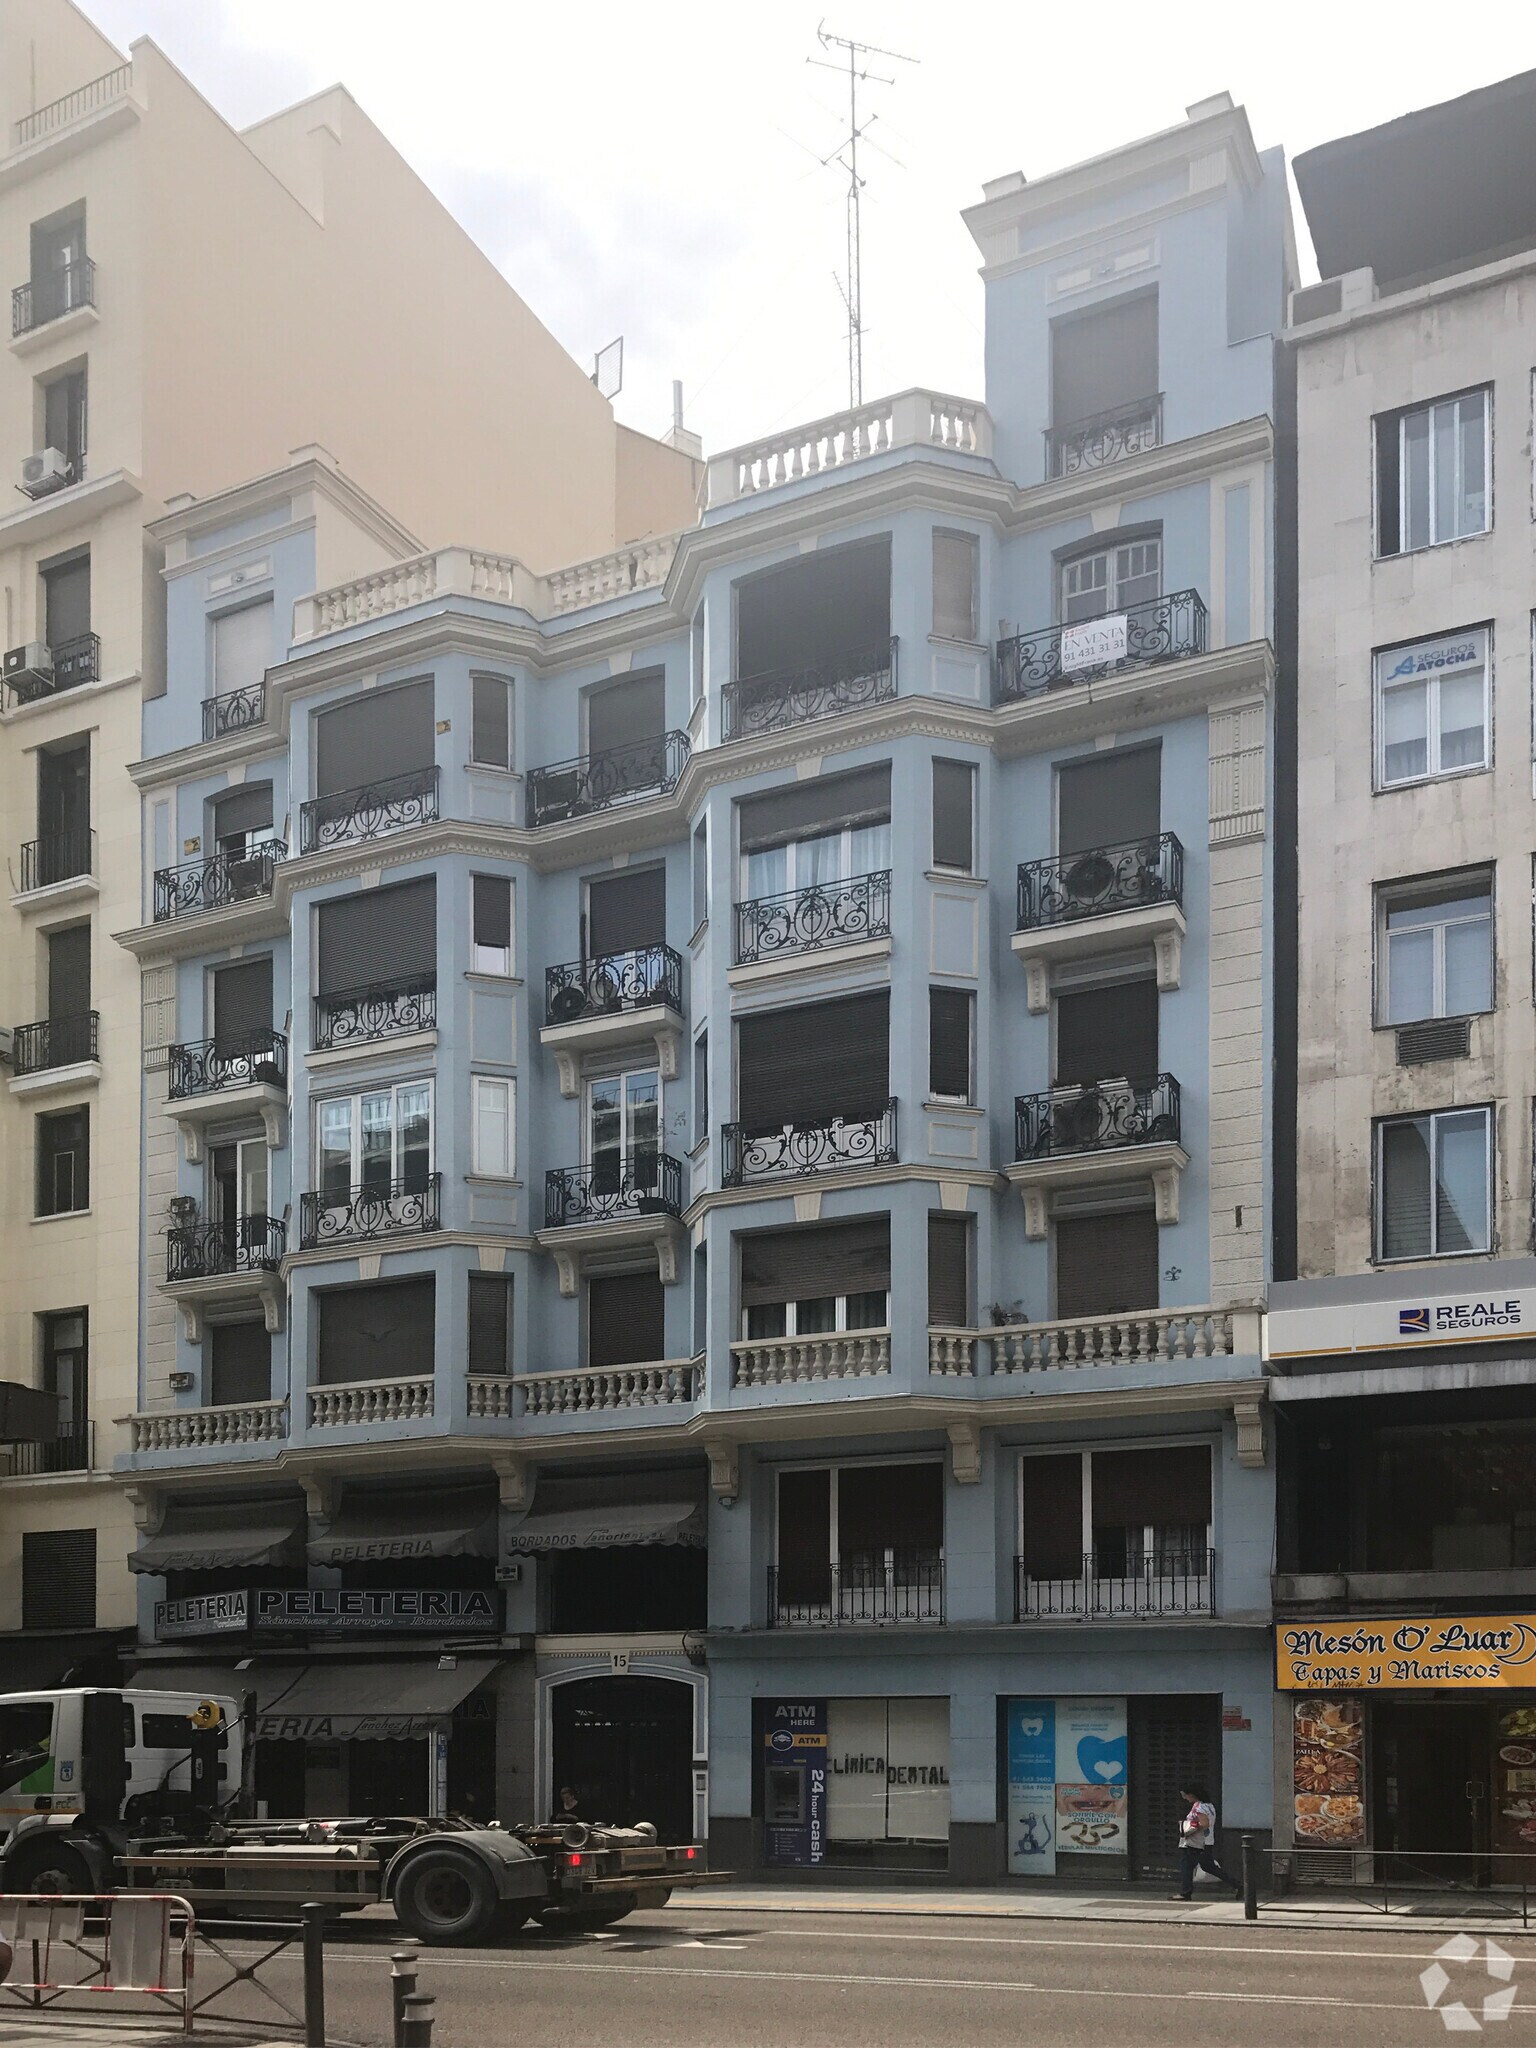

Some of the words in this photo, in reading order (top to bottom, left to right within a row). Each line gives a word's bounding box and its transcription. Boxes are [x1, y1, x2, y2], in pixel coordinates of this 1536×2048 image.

[1064, 638, 1081, 651] EN
[1085, 627, 1125, 644] VENTA
[1064, 653, 1076, 662] 91
[1078, 646, 1096, 658] 431
[1099, 643, 1110, 653] 31
[1114, 639, 1126, 649] 31
[1417, 642, 1476, 663] SEGUROS
[1416, 651, 1477, 673] ATOCHA
[1436, 1300, 1521, 1319] REALE
[1436, 1314, 1521, 1330] SEGUROS
[331, 1540, 434, 1561] PELETERIA
[511, 1535, 577, 1548] BORDADOS
[156, 1593, 247, 1626] PELETERIA
[258, 1590, 494, 1616] PELETERIA
[332, 1615, 394, 1628] Arroyo
[410, 1616, 494, 1626] Bordados
[1284, 1628, 1387, 1657] Mesón
[1429, 1623, 1514, 1653] Luar
[613, 1655, 626, 1667] 15
[1291, 1660, 1362, 1686] Tapas
[1367, 1665, 1382, 1685] y
[1387, 1659, 1501, 1681] Mariscos
[775, 1705, 816, 1718] ATM
[256, 1717, 333, 1736] ERIA
[797, 1737, 821, 1745] ATM
[811, 1769, 825, 1793] 24
[887, 1766, 950, 1785] DENTAL
[811, 1795, 820, 1818] hour
[811, 1820, 823, 1863] cash
